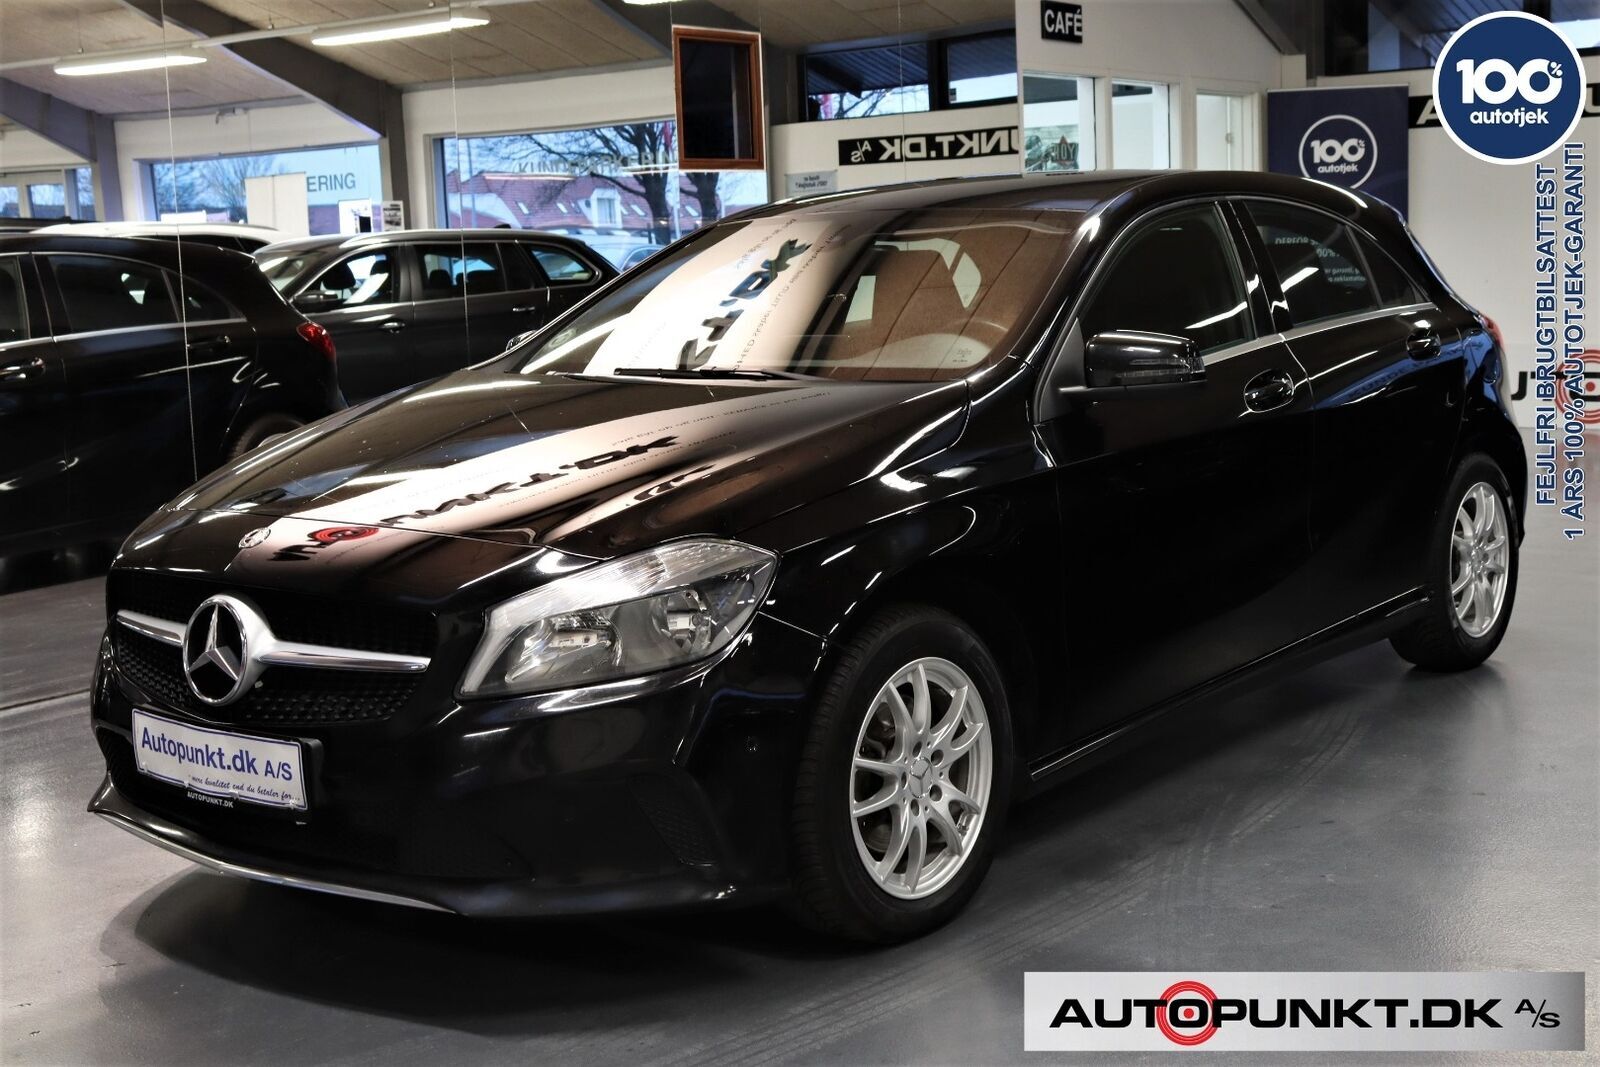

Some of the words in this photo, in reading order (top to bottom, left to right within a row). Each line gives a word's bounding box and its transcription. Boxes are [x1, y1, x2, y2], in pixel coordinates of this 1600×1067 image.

[1044, 8, 1082, 36] CAFÉ
[1310, 138, 1365, 163] 100%
[1317, 163, 1358, 174] autotjek
[306, 172, 356, 192] ERING
[142, 727, 259, 775] Autopunkt.dk
[264, 760, 293, 781] A/S
[187, 791, 234, 808] AUTOPUNKT.DK
